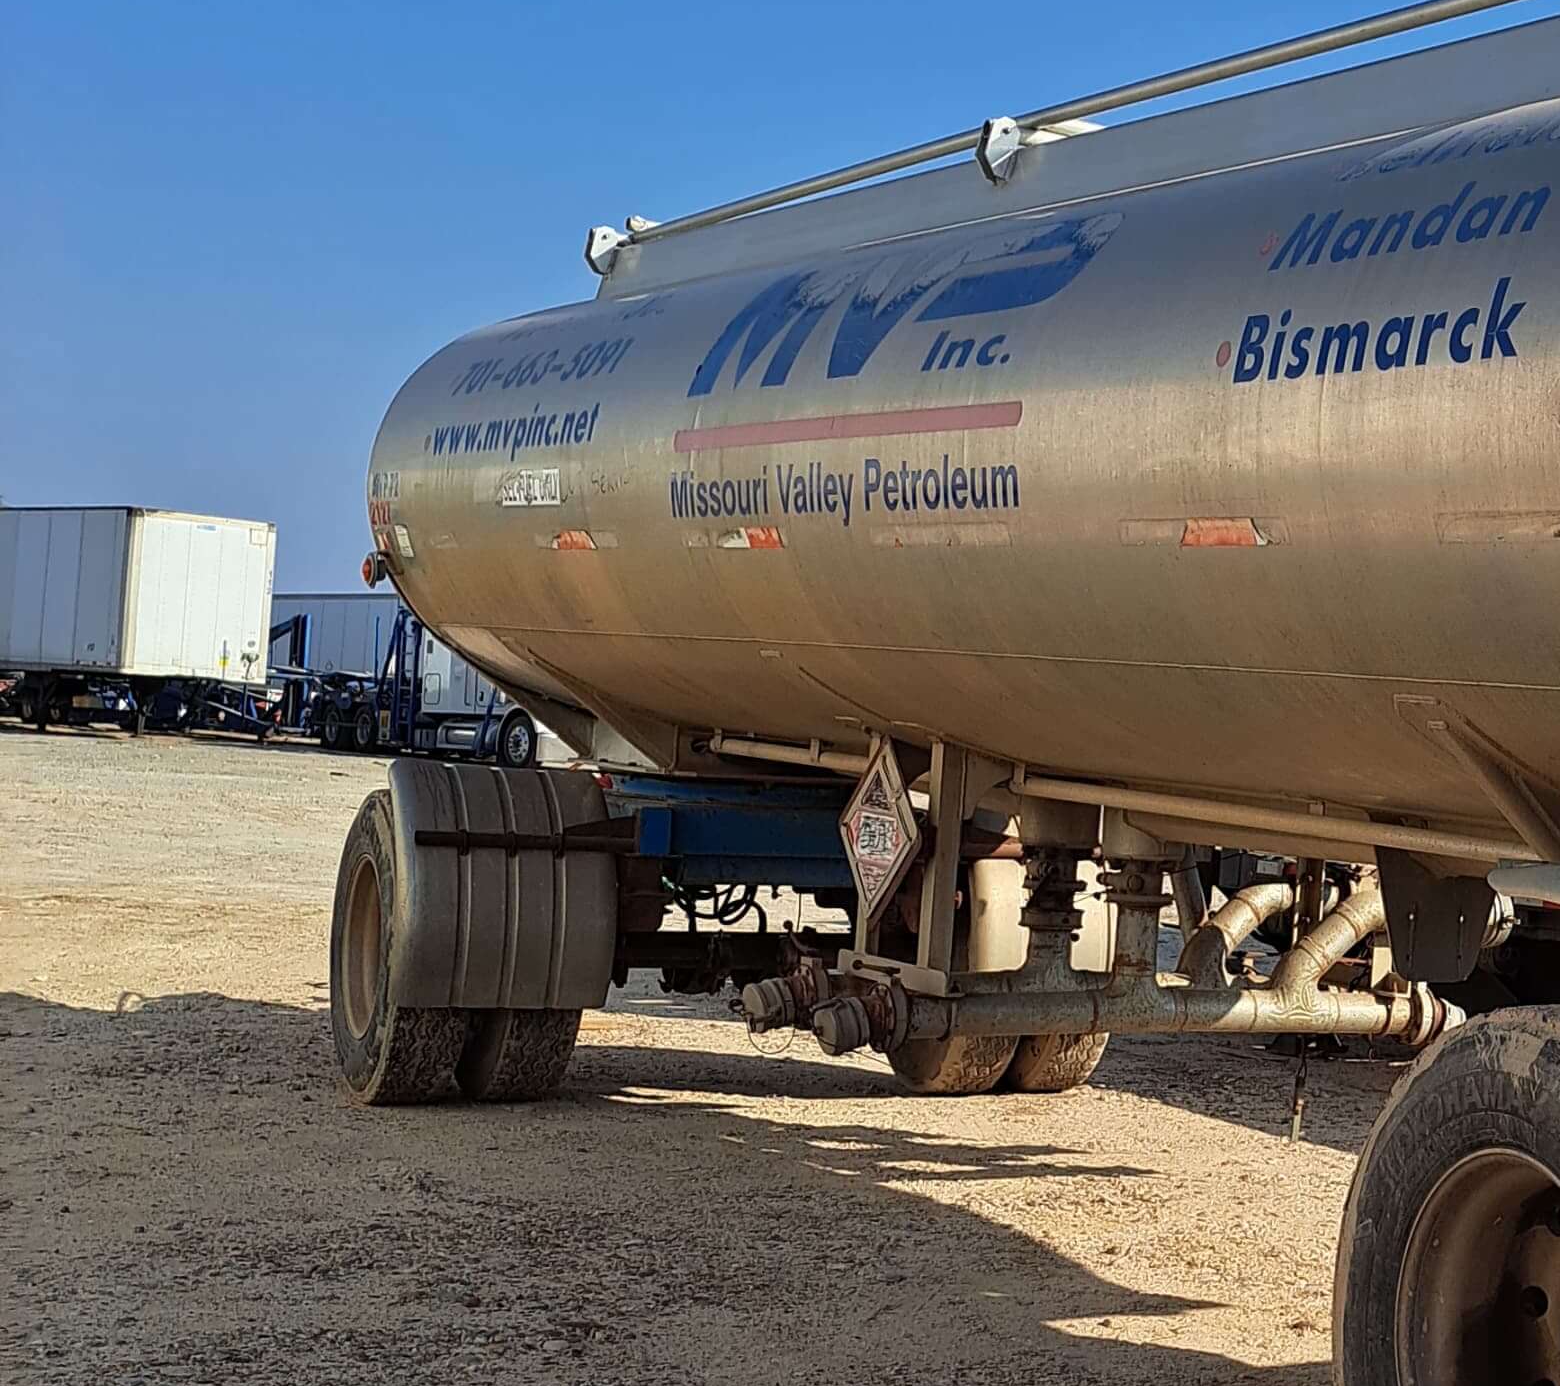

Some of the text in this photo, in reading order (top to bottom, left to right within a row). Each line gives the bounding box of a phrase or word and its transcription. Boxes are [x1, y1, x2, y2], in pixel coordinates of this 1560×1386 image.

[1268, 180, 1551, 271] Mandan
[921, 331, 1011, 371] Inc.
[1232, 277, 1527, 383] Bismarck
[451, 337, 634, 396] 701-663-5091
[433, 402, 600, 462] www.mvpinc.net
[670, 470, 768, 519] Missouri
[776, 464, 853, 526] Valley
[864, 454, 1020, 514] Petroleum
